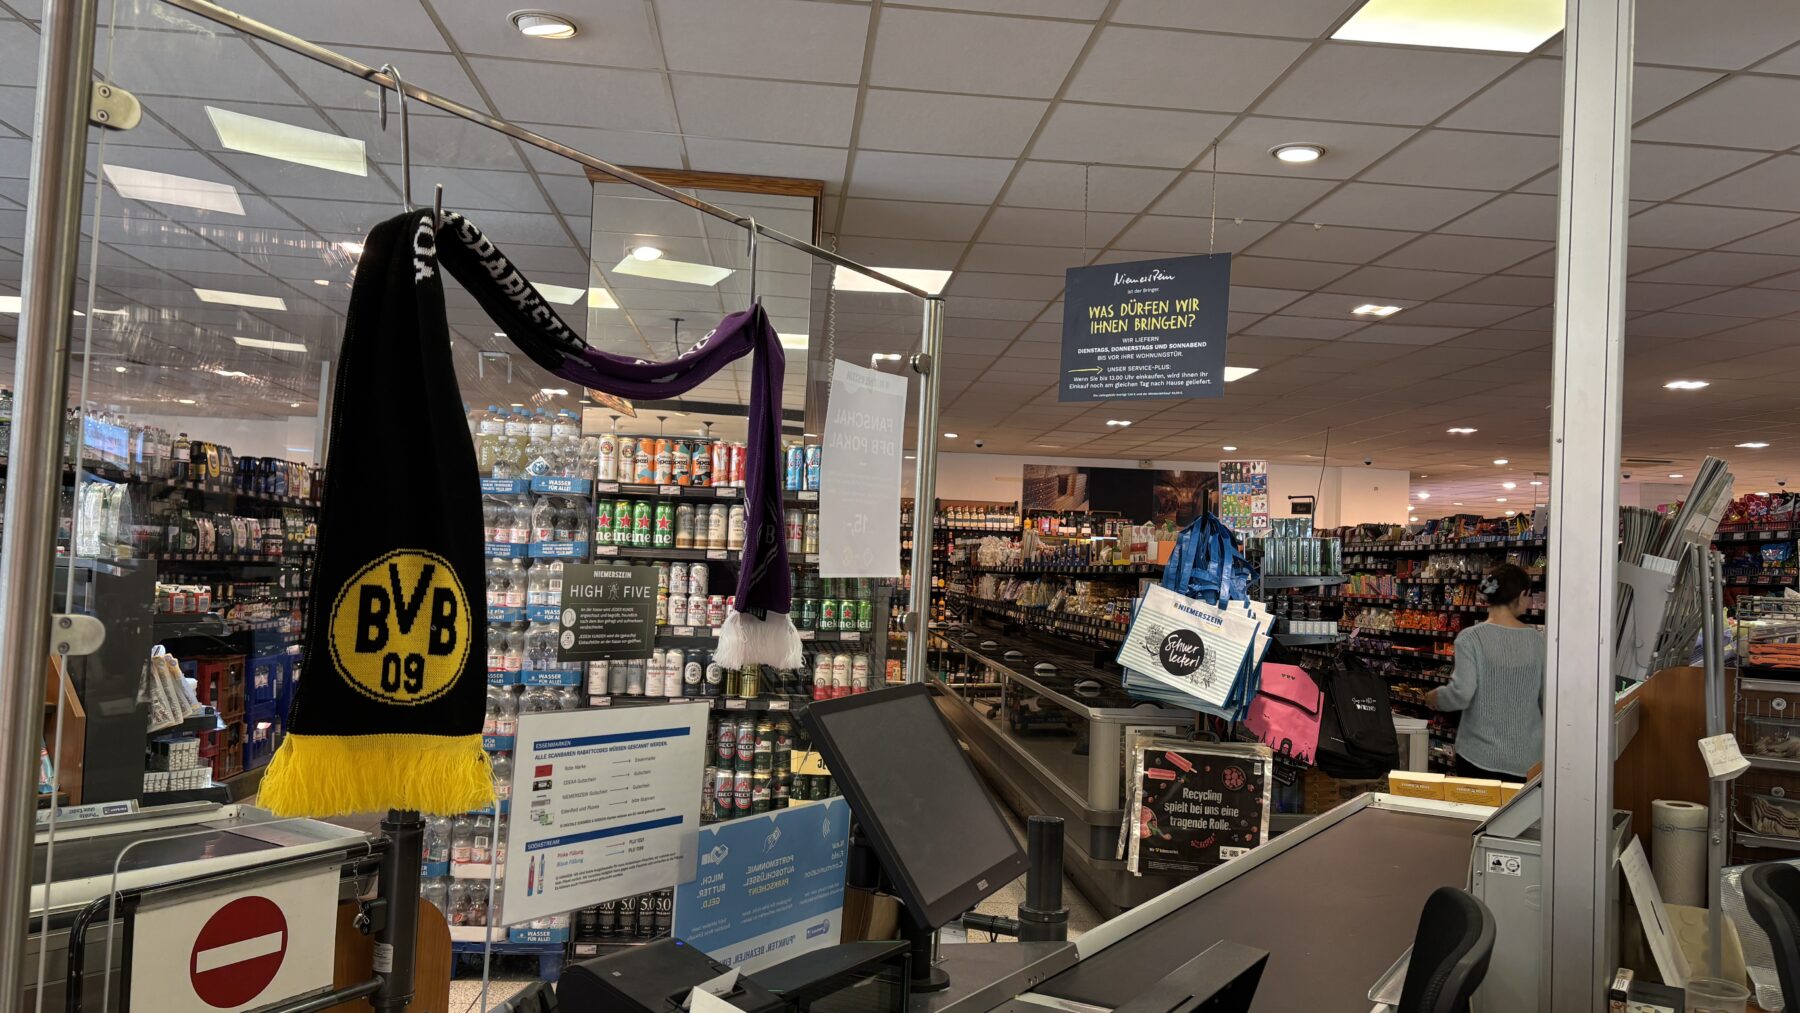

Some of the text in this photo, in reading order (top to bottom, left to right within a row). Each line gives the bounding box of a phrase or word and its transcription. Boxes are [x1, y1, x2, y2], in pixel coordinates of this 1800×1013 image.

[1088, 297, 1200, 319] WAS DÜRFEN WIR
[1090, 314, 1196, 334] IHNEN BRINGEN?
[1111, 345, 1154, 353] DONNERSTAGS
[1169, 341, 1207, 349] SONNABEND
[1135, 350, 1183, 359] WOHNUNGSTÜR.
[1128, 364, 1172, 372] SERVICE-PLUS:
[1114, 381, 1139, 389] gleichen
[1185, 378, 1212, 386] geliefert.
[593, 570, 632, 579] NIEMERSZEIN
[570, 584, 651, 598] HIGH FIVE
[355, 563, 457, 656] BVB
[1174, 602, 1223, 626] #NIEMERSZEIN
[380, 652, 426, 694] 09
[535, 740, 572, 749] ESSENMARKEN
[548, 751, 576, 759] SCANBAREN
[627, 742, 649, 750] GESCANNT
[1182, 787, 1223, 804] Recycling
[1163, 801, 1239, 817] spielt bei uns eine
[1169, 816, 1232, 831] tragende Rolle.
[527, 839, 560, 850] SODASTREAM
